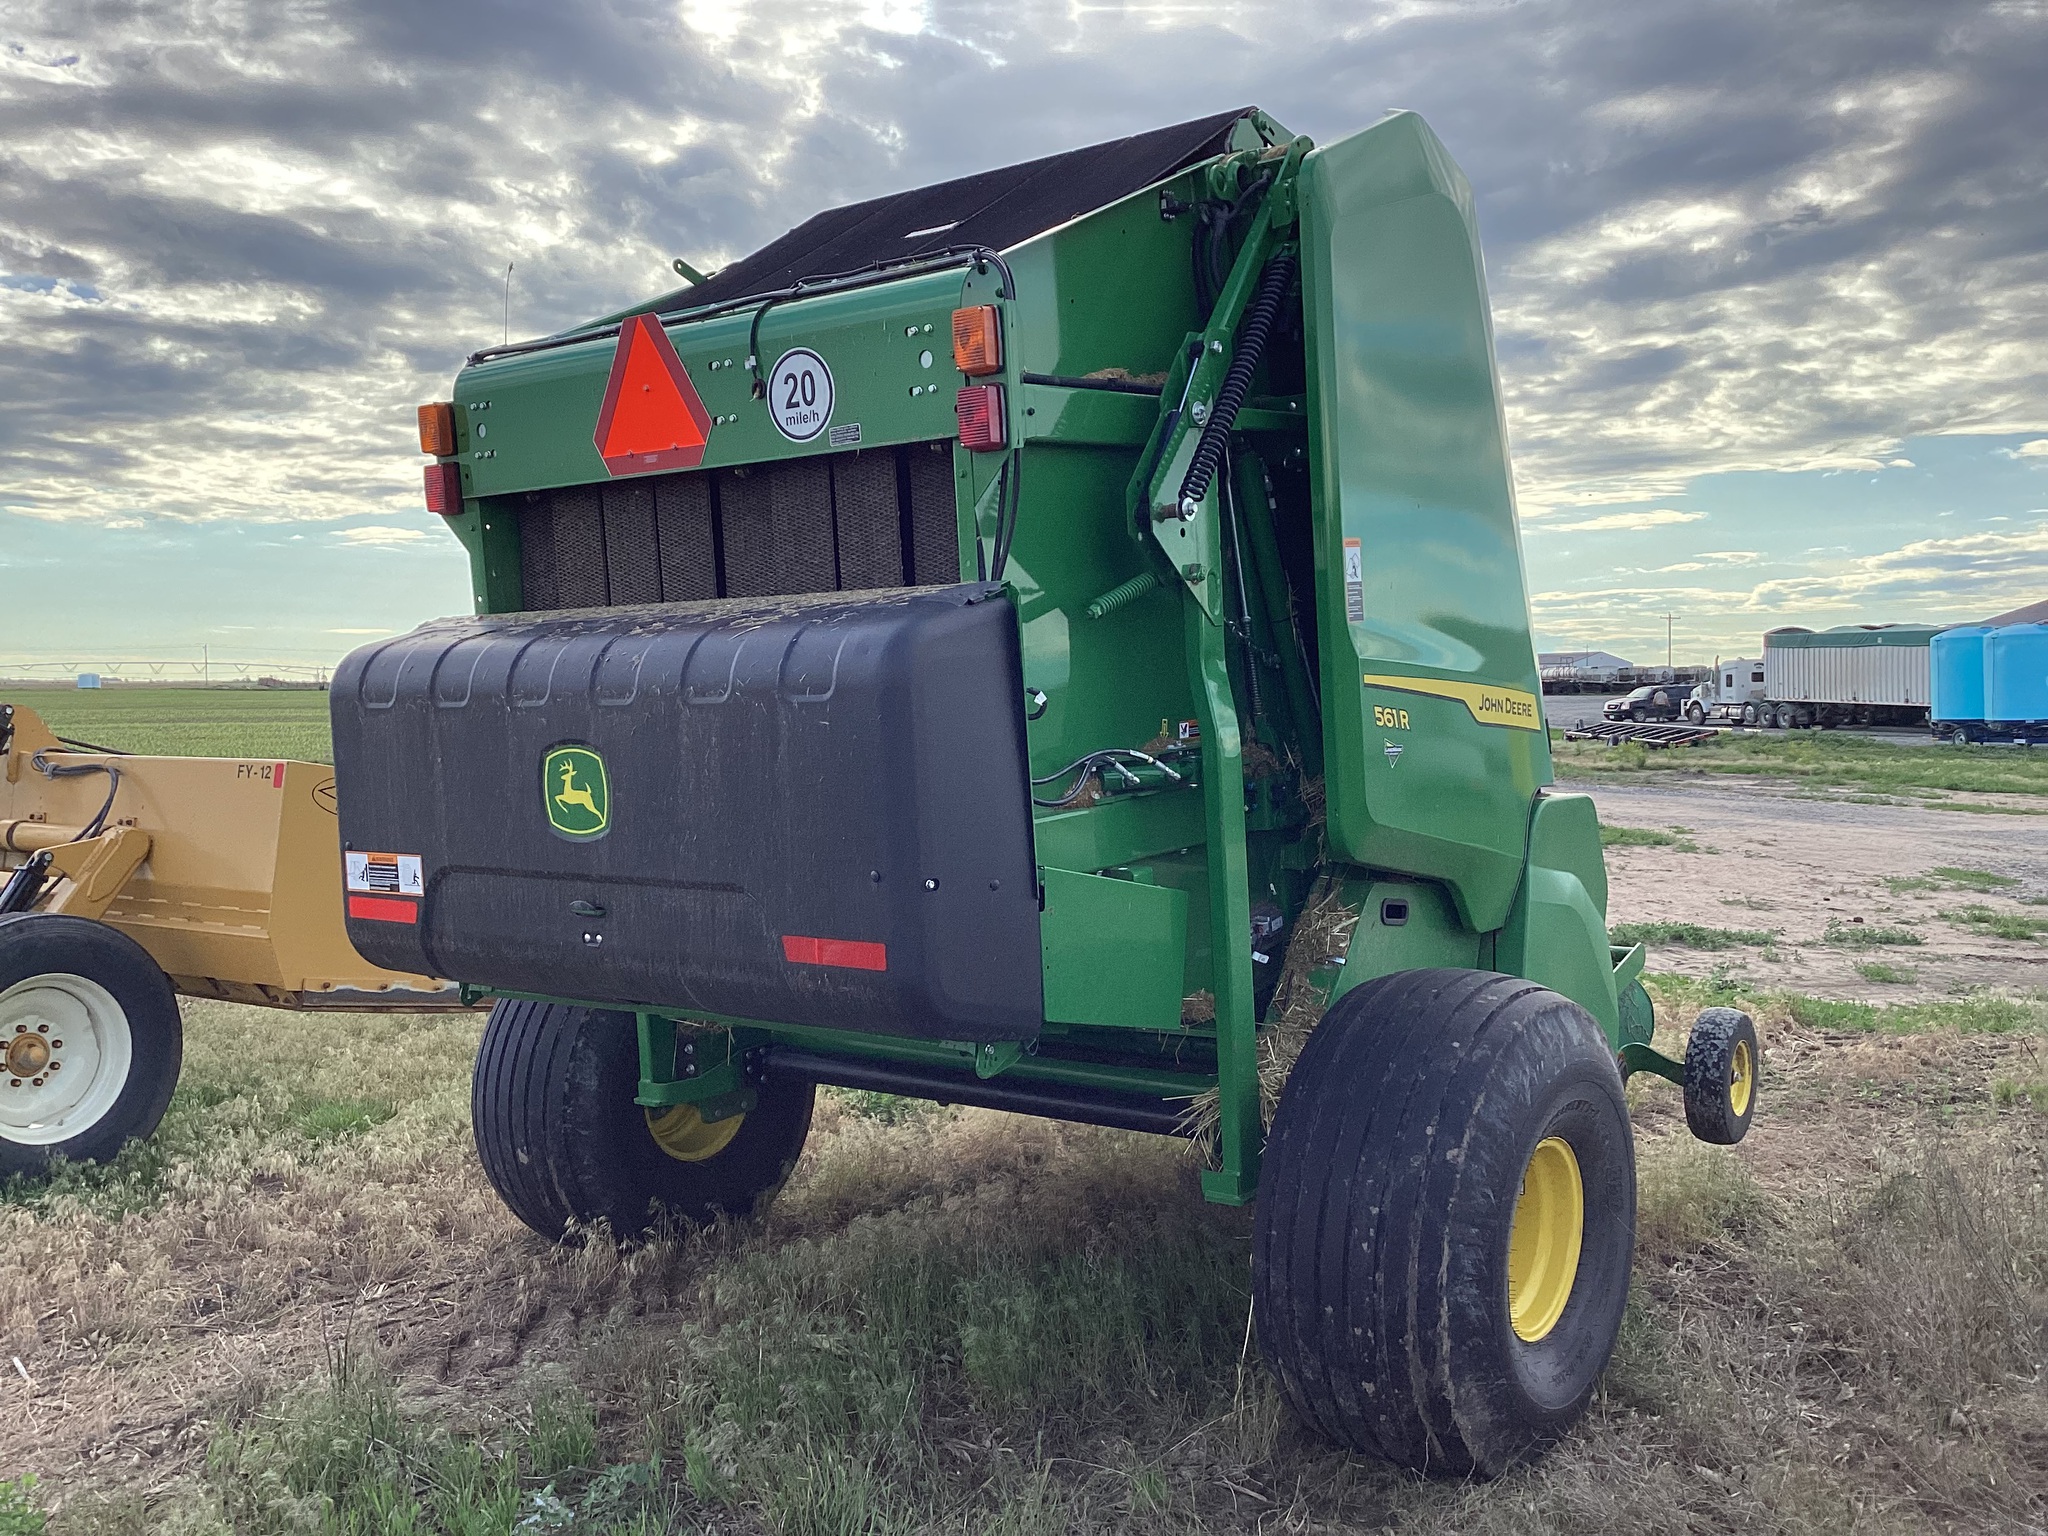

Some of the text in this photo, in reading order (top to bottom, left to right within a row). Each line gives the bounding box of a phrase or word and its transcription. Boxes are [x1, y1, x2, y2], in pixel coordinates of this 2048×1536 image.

[783, 369, 816, 410] 20
[785, 410, 820, 426] mile/h
[1479, 693, 1533, 717] JOHN DEERE
